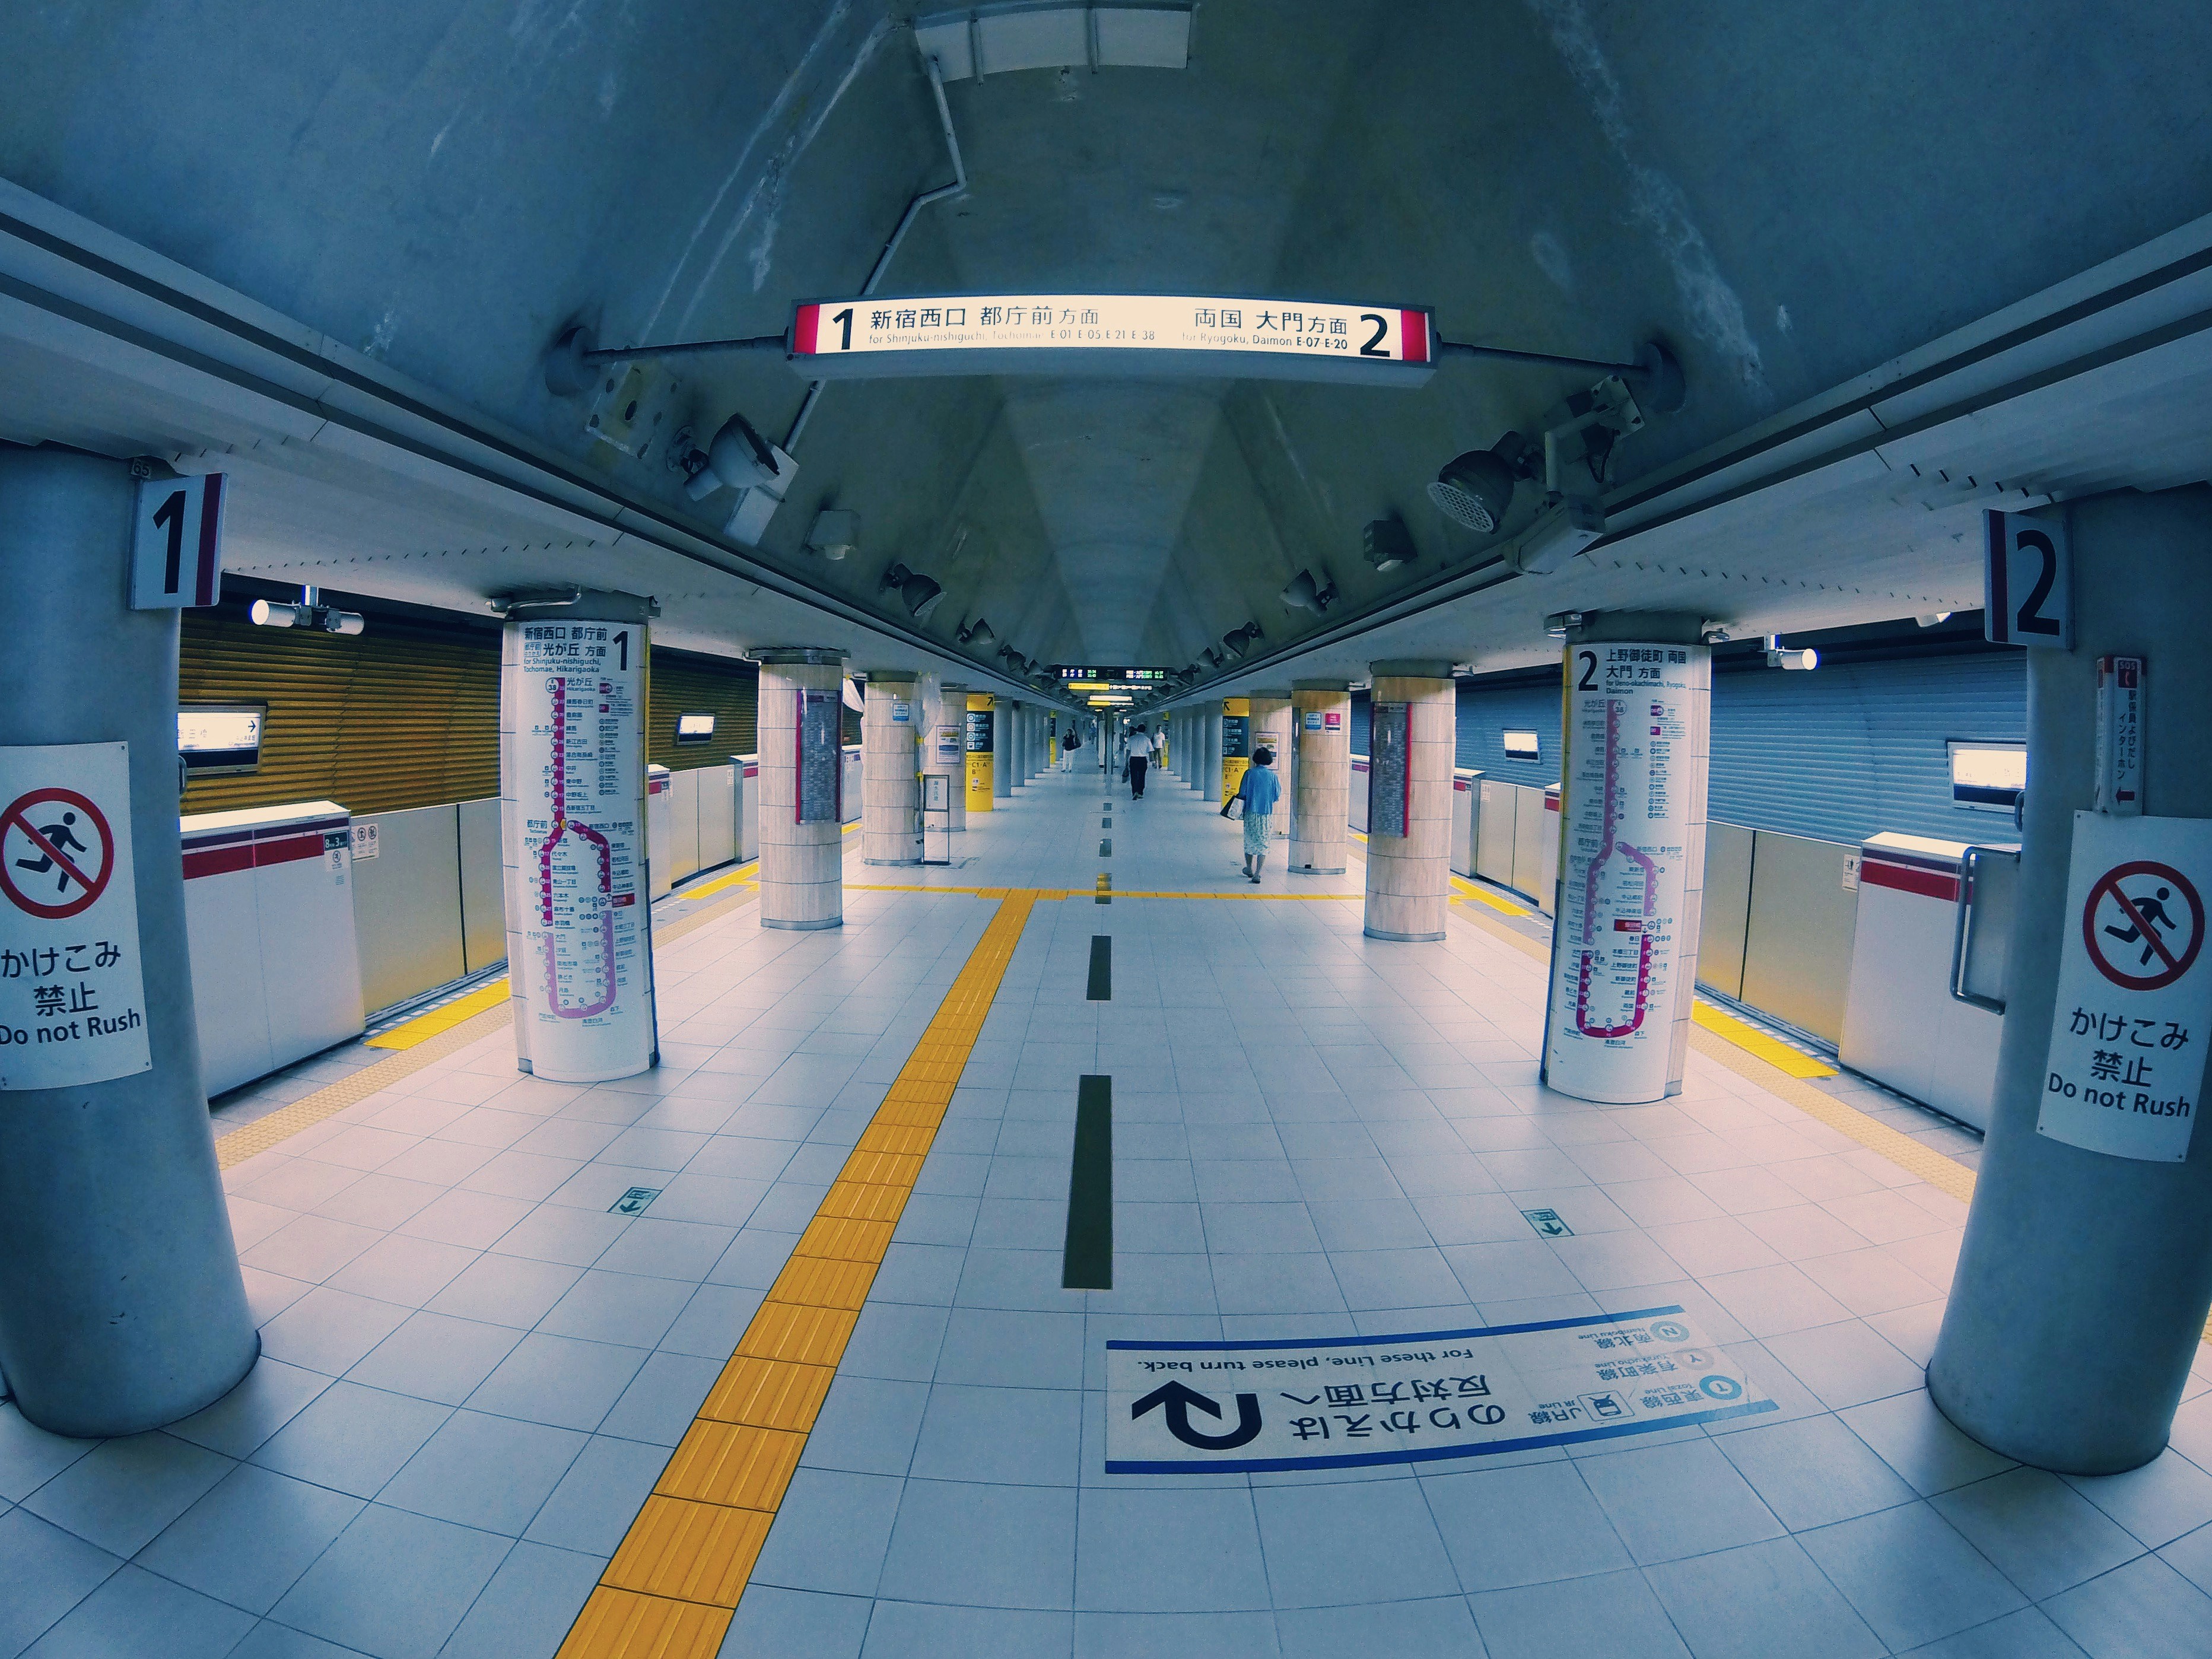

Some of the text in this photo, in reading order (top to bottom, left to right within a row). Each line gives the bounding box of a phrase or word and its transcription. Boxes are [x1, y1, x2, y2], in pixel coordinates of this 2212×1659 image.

[832, 308, 853, 350] 1
[870, 308, 966, 329] 新宿西口
[1194, 308, 1241, 329] 両国
[869, 335, 883, 344] for
[1200, 333, 1249, 345] Ryogoku,
[1253, 335, 1292, 346] Daimon
[1360, 313, 1390, 357] 2
[153, 490, 186, 594] 1
[2017, 529, 2060, 635] 2
[525, 627, 607, 641] 新宿西口 都庁前
[533, 657, 601, 666] Shinjuku-nishiguchi,
[543, 643, 606, 657] 光が丘 方面
[613, 631, 628, 670] 1
[1606, 649, 1686, 664] 上野御徒町 両国
[1578, 650, 1598, 691] 2
[1606, 665, 1661, 679] 大門 方面
[2119, 661, 2136, 669] SOS
[567, 678, 593, 686] 光が丘
[2118, 713, 2127, 779] インターホン
[1, 941, 121, 978] かけこみ
[34, 982, 98, 1017] 禁止
[0, 1008, 141, 1045] Do not Rush
[2070, 1007, 2189, 1051] かけこみ
[2090, 1048, 2153, 1088] 禁止
[2048, 1072, 2191, 1118] Do not Rush
[1593, 1331, 1654, 1349] 南北線
[1137, 1348, 1473, 1372] For these Line, please turn back.
[1280, 1374, 1492, 1409] 反対方面へ
[1563, 1399, 1575, 1407] JR
[1639, 1388, 1704, 1409] 東西線
[1289, 1404, 1506, 1441] のりかえは
[1527, 1407, 1581, 1424] JR線
